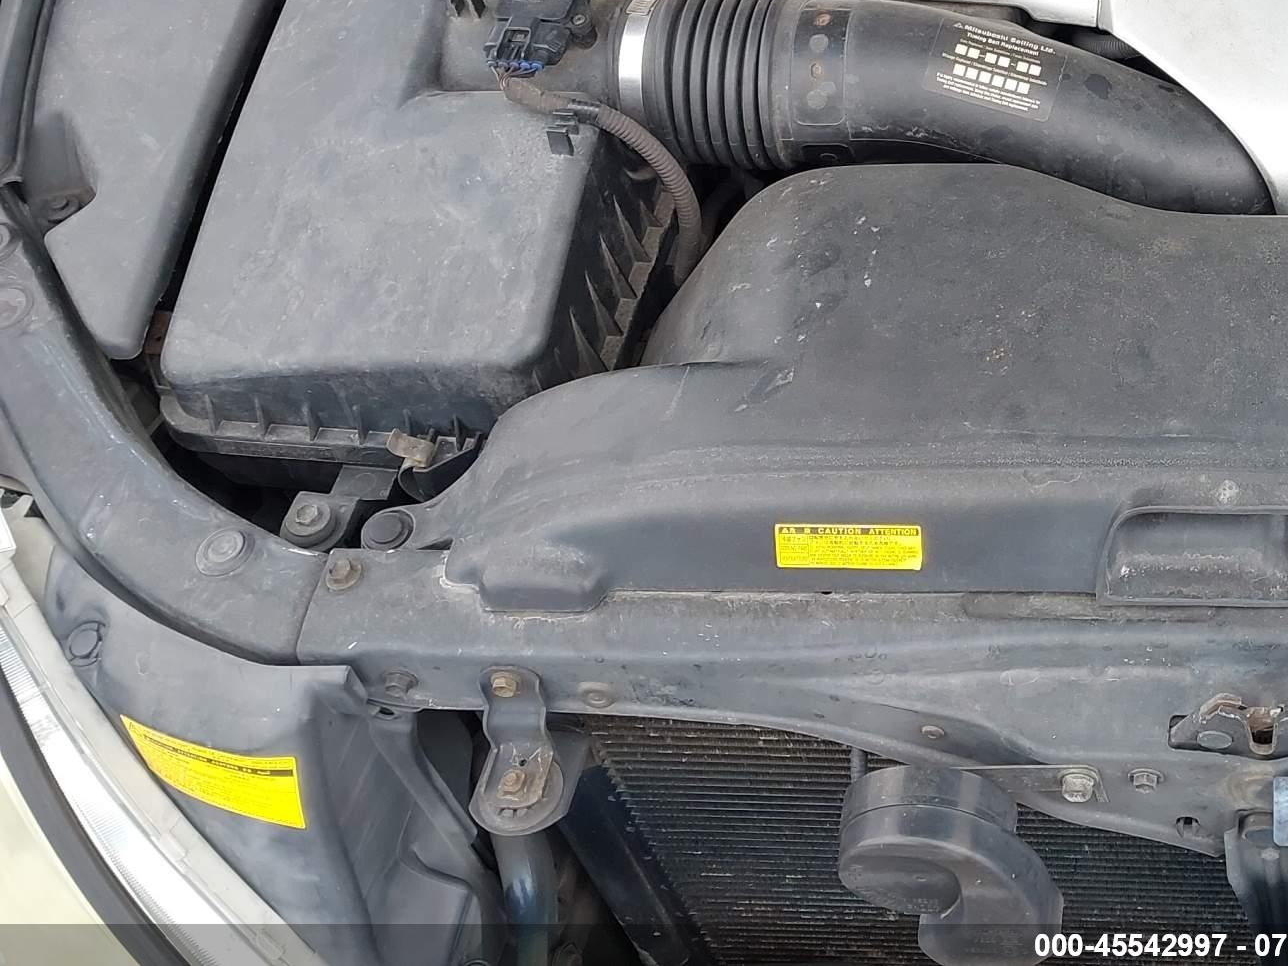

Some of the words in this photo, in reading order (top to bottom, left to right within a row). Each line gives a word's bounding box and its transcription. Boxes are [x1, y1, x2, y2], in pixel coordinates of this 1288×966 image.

[967, 32, 986, 43] Timing
[987, 38, 1000, 46] Belt
[1000, 41, 1039, 56] Replacement
[1040, 45, 1056, 55] Ltd.
[869, 528, 917, 536] ATTENTION
